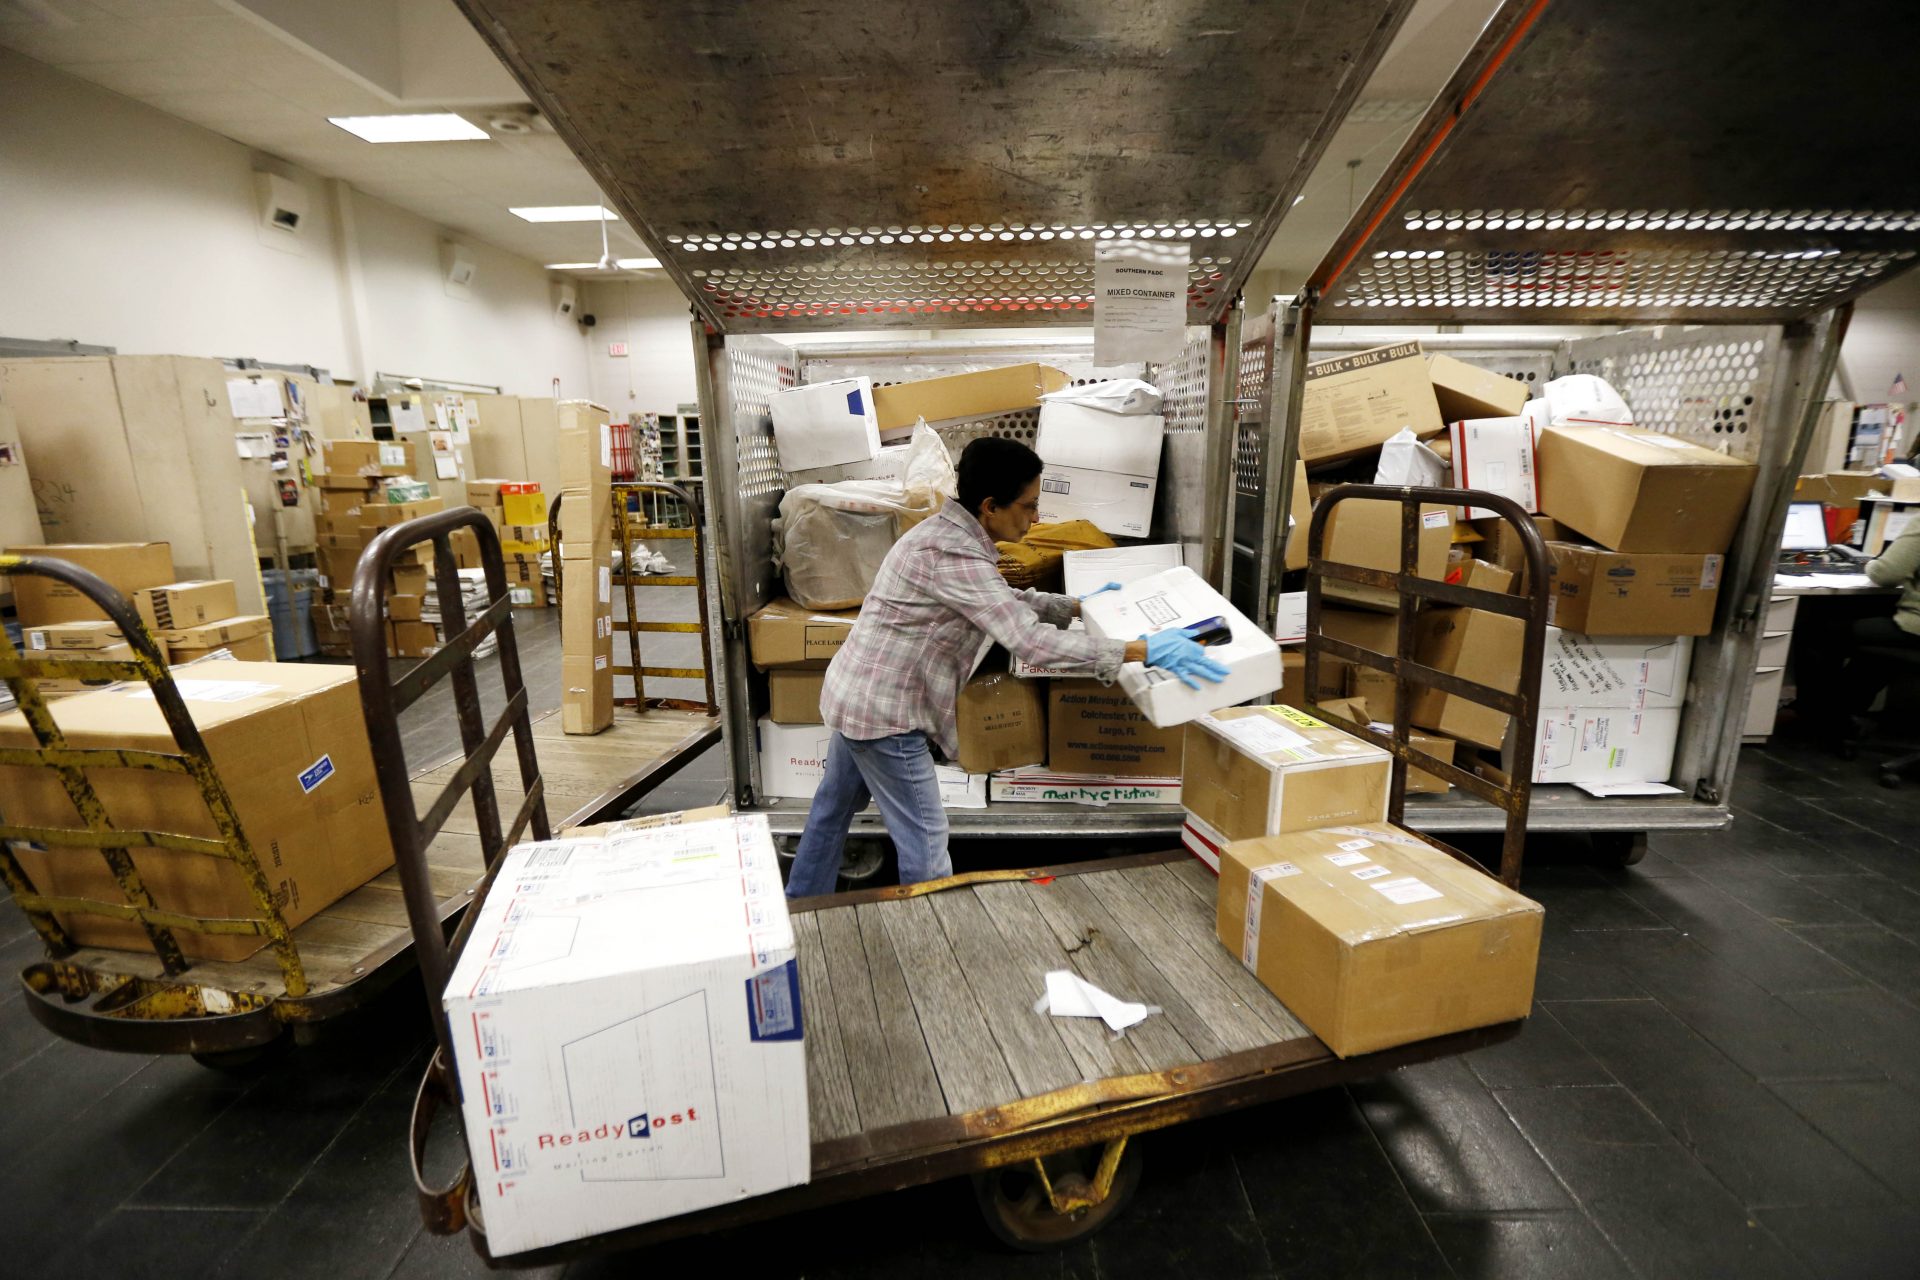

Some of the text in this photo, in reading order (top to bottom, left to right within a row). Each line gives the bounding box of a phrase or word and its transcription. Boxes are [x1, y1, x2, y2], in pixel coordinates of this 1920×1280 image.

[1107, 288, 1176, 298] MIXED CONTAINER
[1316, 343, 1417, 376] BULK BULK BULK
[1059, 694, 1087, 704] Action
[1088, 696, 1119, 706] Moving
[1081, 710, 1126, 721] Colchester,
[1128, 712, 1139, 721] VT
[1098, 726, 1137, 736] Largo, FL
[790, 757, 827, 769] Ready
[538, 1108, 698, 1150] ReadyPost
[554, 1155, 609, 1170] Mailing
